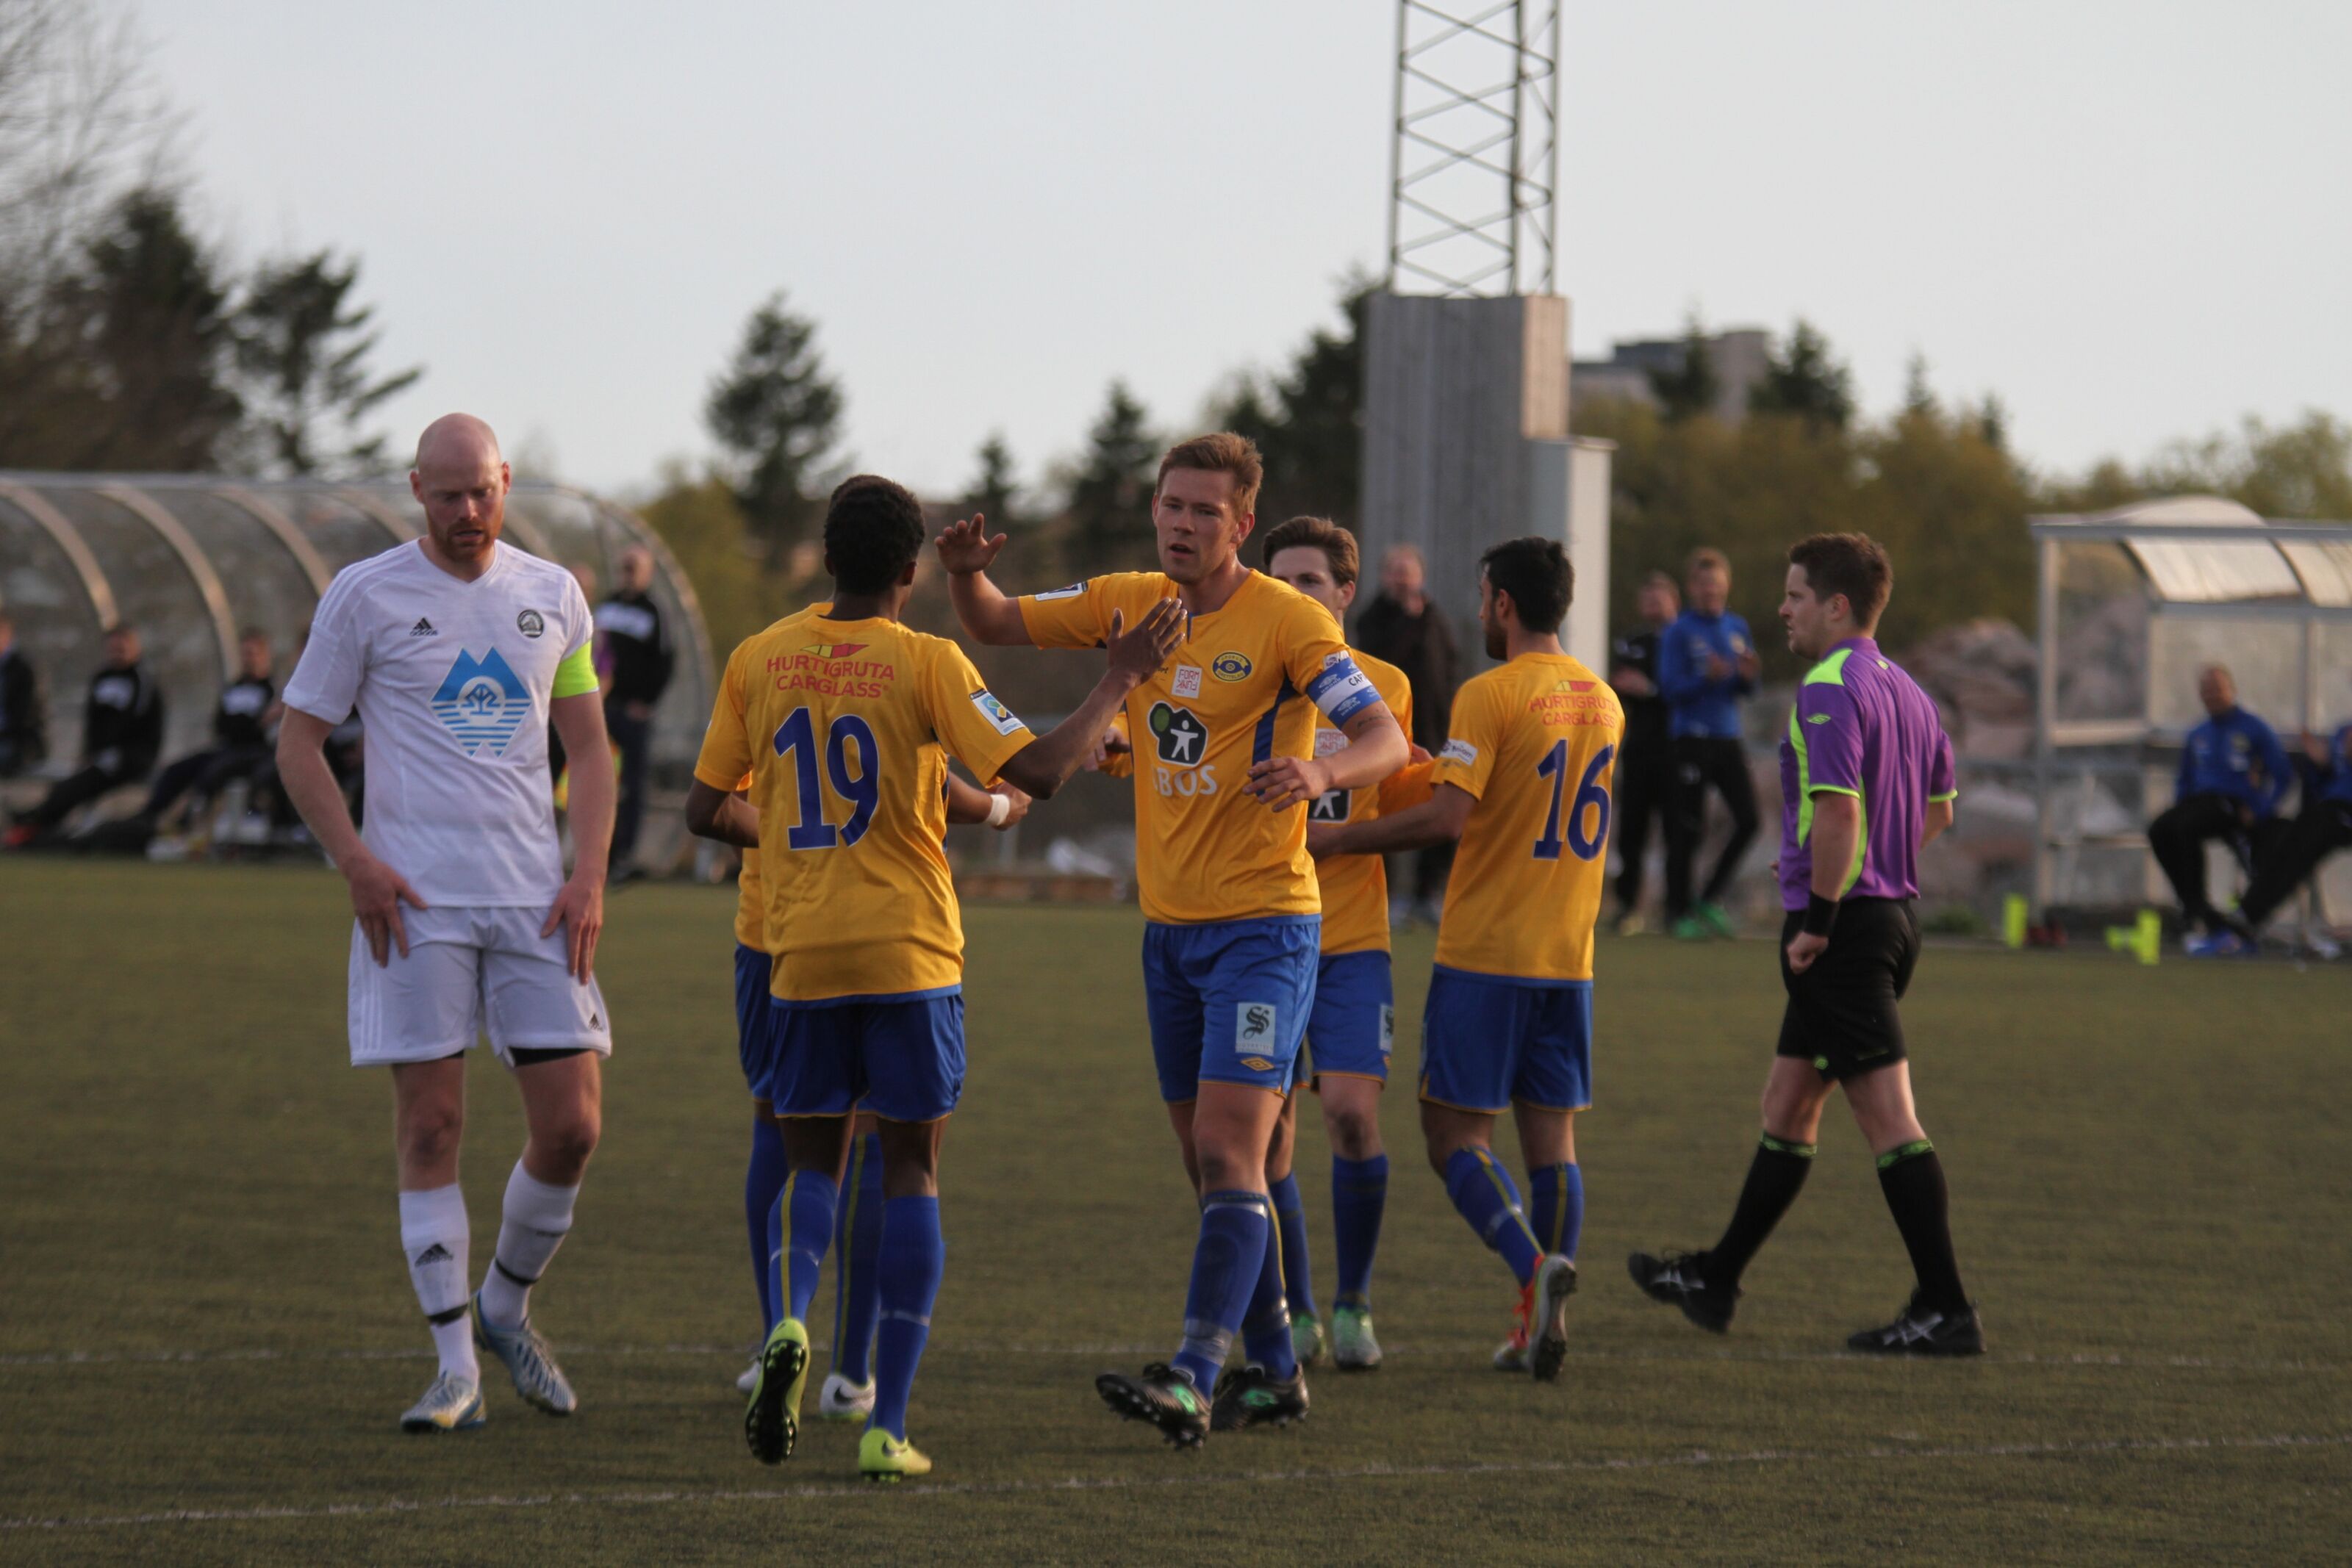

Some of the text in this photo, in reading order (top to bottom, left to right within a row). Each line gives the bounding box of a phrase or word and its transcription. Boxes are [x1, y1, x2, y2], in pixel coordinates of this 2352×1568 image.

[767, 655, 894, 681] HURTIGRUTA
[773, 707, 879, 850] 19
[1153, 765, 1218, 796] BOS
[1533, 738, 1614, 861] 16
